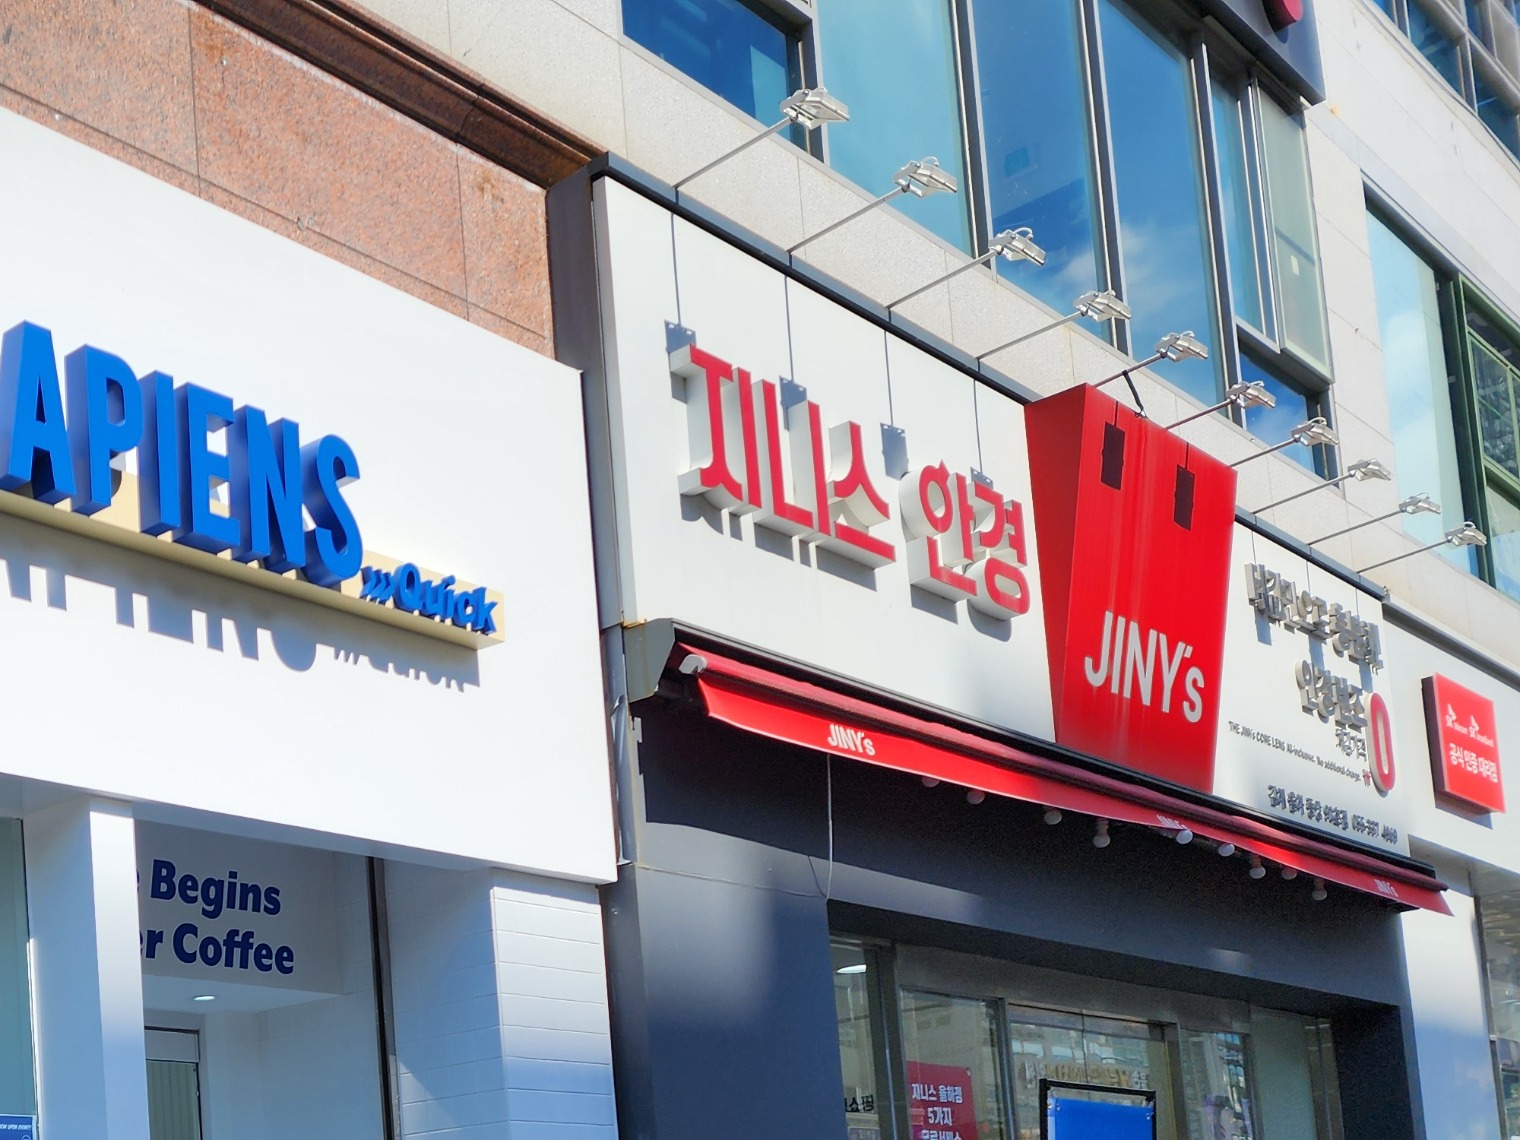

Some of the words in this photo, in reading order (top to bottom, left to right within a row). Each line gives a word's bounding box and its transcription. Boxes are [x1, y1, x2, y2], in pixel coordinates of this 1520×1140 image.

[671, 344, 896, 573] 지니스
[900, 459, 1031, 622] 안경
[392, 562, 498, 636] Quick
[1083, 608, 1206, 724] JINY's
[827, 723, 876, 758] JINY's
[1449, 743, 1465, 769] 공식
[1464, 749, 1479, 775] 인증
[1478, 757, 1499, 784] 대리점
[150, 858, 282, 921] Begins
[172, 922, 295, 976] Coffee
[912, 1083, 938, 1101] 지니스
[927, 1106, 953, 1126] 5가지
